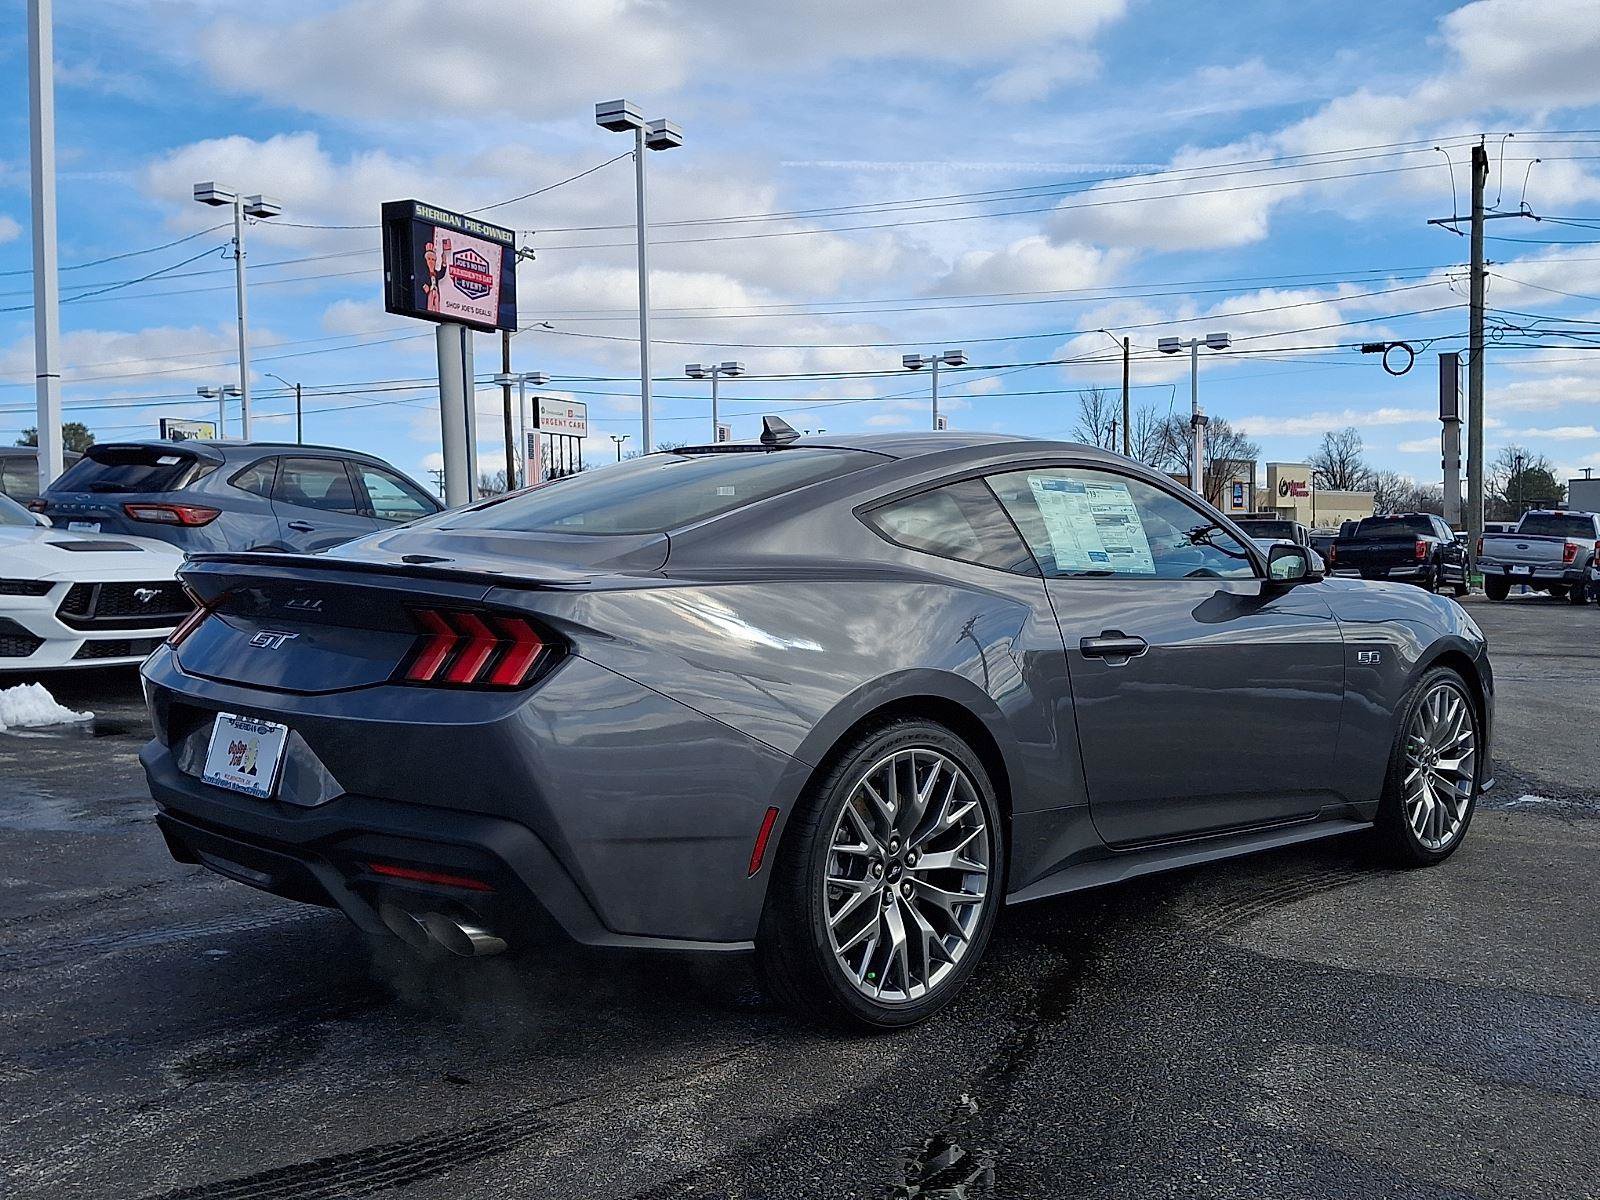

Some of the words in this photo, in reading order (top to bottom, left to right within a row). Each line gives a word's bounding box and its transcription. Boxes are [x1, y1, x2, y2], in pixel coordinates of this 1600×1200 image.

[415, 204, 462, 227] SHERIDAN
[464, 219, 514, 242] PRE-OWNED
[462, 279, 482, 291] EVENT
[446, 300, 461, 310] SHOP
[541, 418, 567, 427] URGENT
[569, 421, 585, 429] CARE
[248, 629, 301, 651] GT
